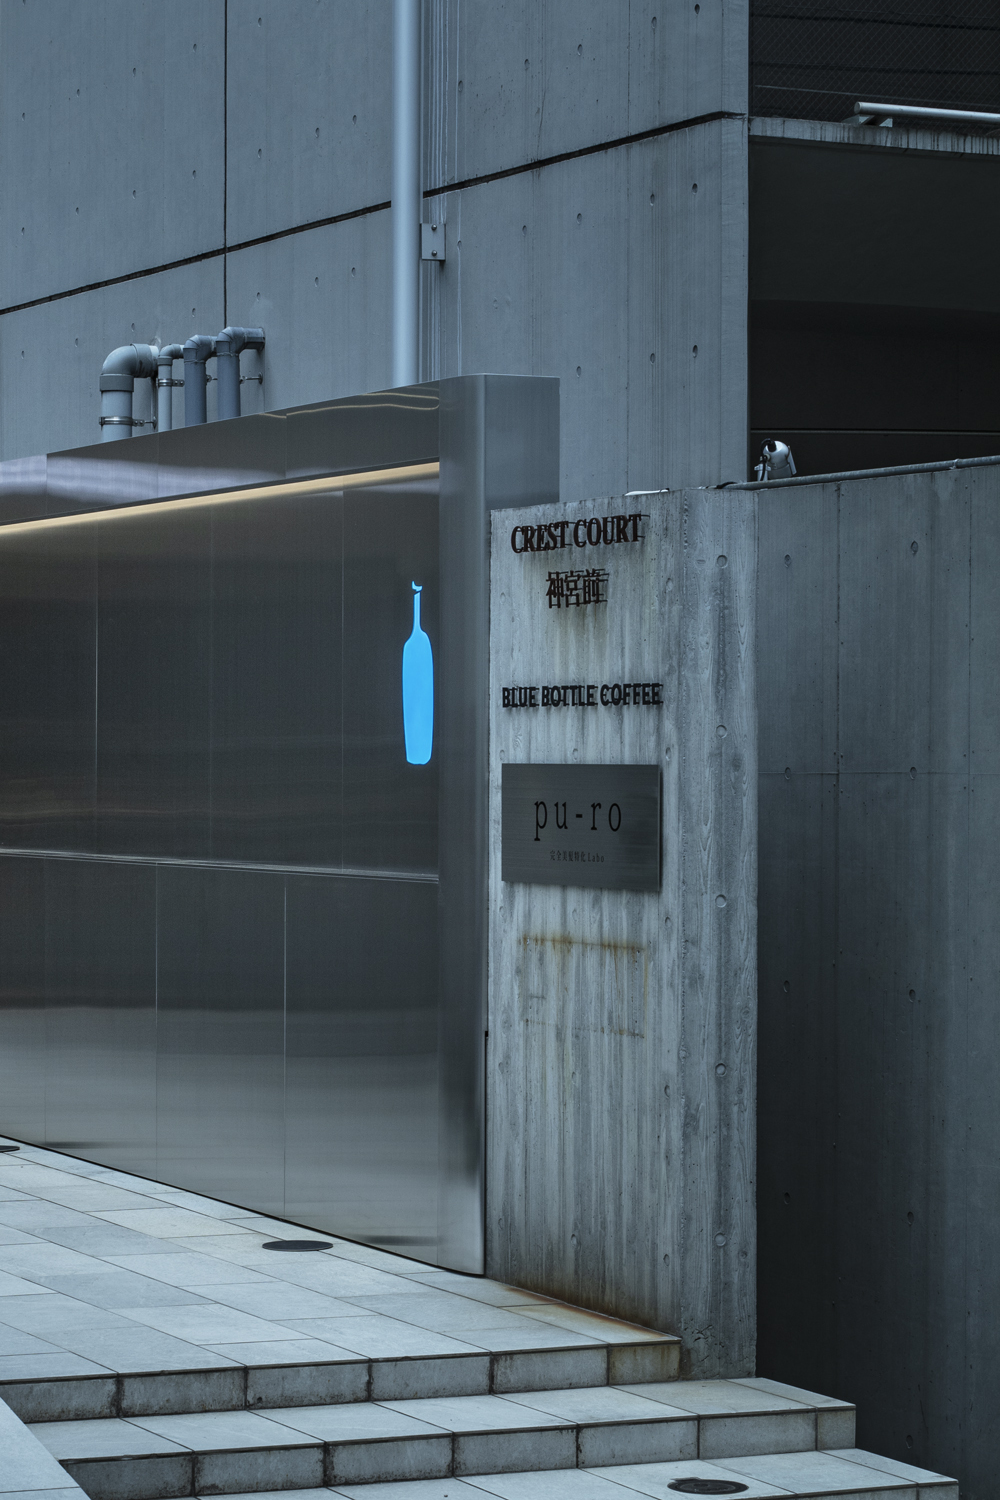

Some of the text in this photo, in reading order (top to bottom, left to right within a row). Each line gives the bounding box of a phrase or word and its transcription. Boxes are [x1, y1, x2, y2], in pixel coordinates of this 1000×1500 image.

[511, 513, 642, 554] CREST COURT
[546, 568, 603, 609] 神宮前
[502, 682, 661, 708] BLUE BOTTLE COFFEE
[533, 800, 622, 842] pu-ro
